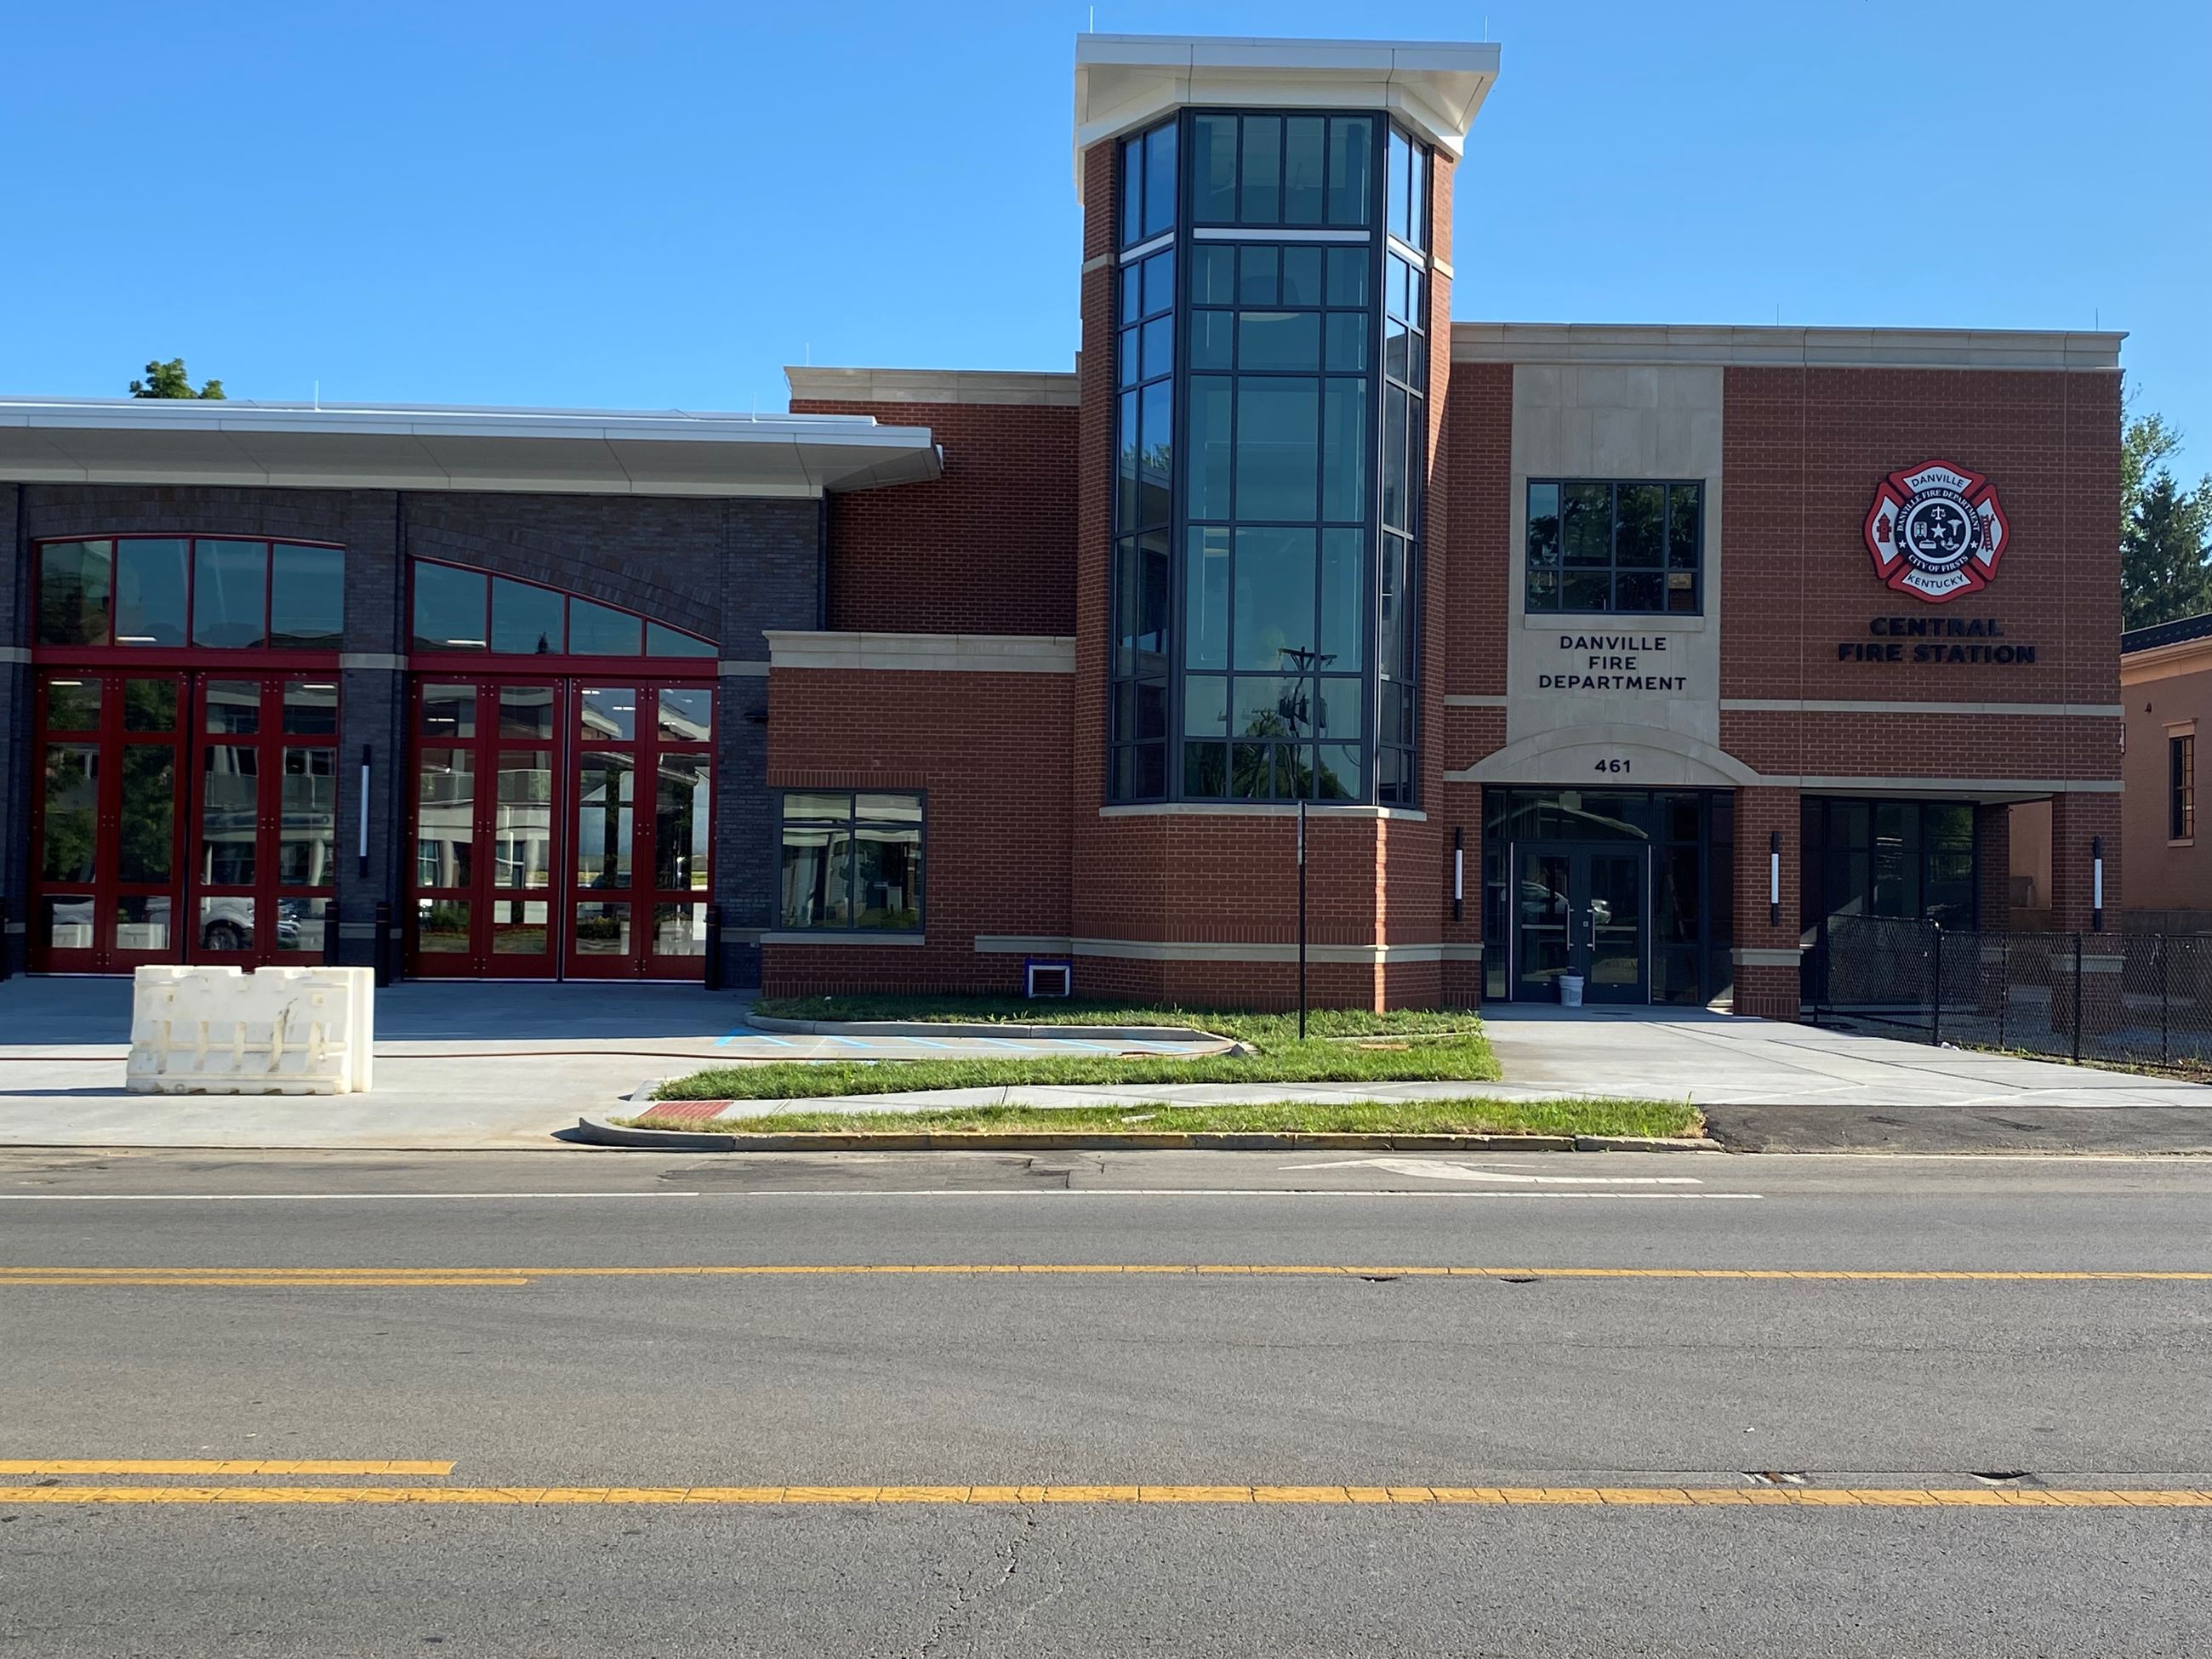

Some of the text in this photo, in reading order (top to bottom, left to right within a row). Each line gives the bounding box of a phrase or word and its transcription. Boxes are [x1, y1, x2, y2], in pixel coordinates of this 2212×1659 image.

[1911, 473, 1964, 487] DANVILLE
[1896, 490, 1980, 532] DANVILLE FIRE DEPARTMENT
[1907, 554, 1928, 570] CITY
[1941, 555, 1970, 572] FIRSTS
[1907, 573, 1964, 589] KENTUCKY
[1869, 617, 2004, 636] CENTRAL
[1559, 636, 1667, 651] DANVILLE
[1839, 643, 2035, 664] FIRE STATION
[1589, 657, 1637, 670] FIRE
[1539, 676, 1686, 690] DEPARTMENT
[1595, 759, 1631, 773] 461
